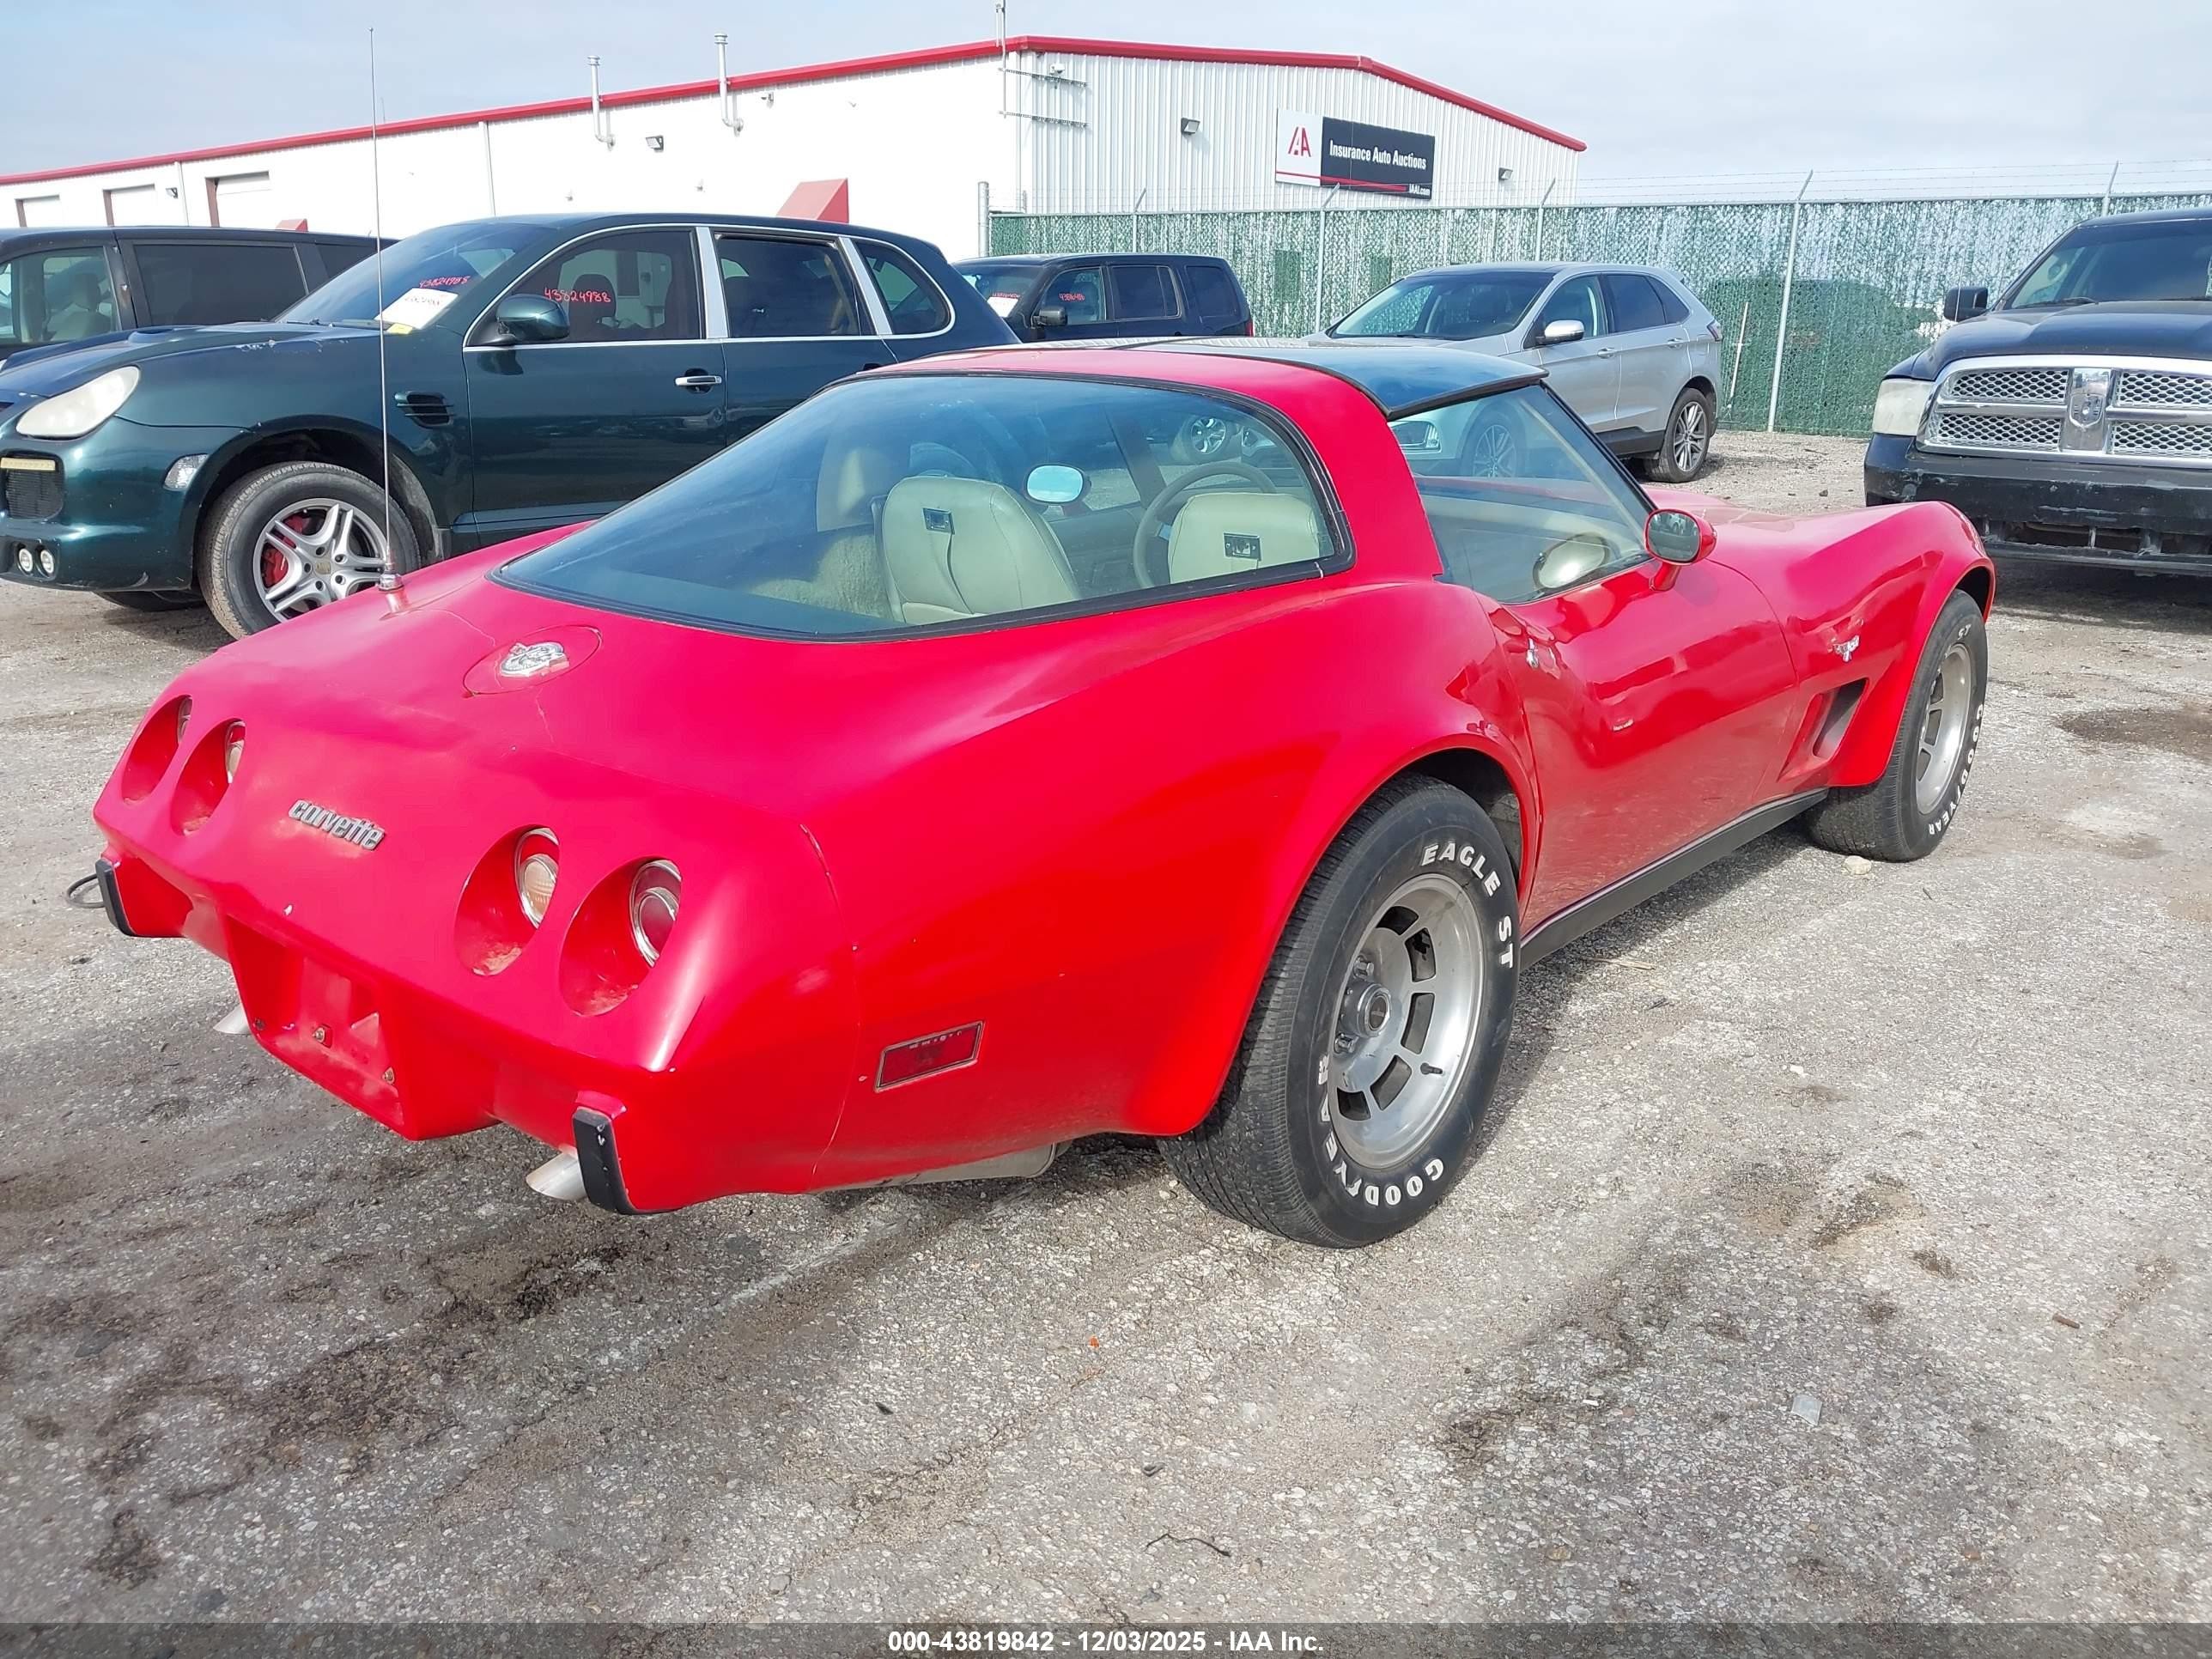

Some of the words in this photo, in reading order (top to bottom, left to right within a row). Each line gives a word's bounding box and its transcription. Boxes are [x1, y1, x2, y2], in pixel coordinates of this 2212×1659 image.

[1329, 139, 1372, 162] Insurance
[1372, 146, 1392, 166] Auto
[1392, 149, 1428, 170] Auctions
[544, 287, 612, 303] 43824988
[1421, 842, 1502, 897] EAGLE
[1497, 915, 1514, 969] ST
